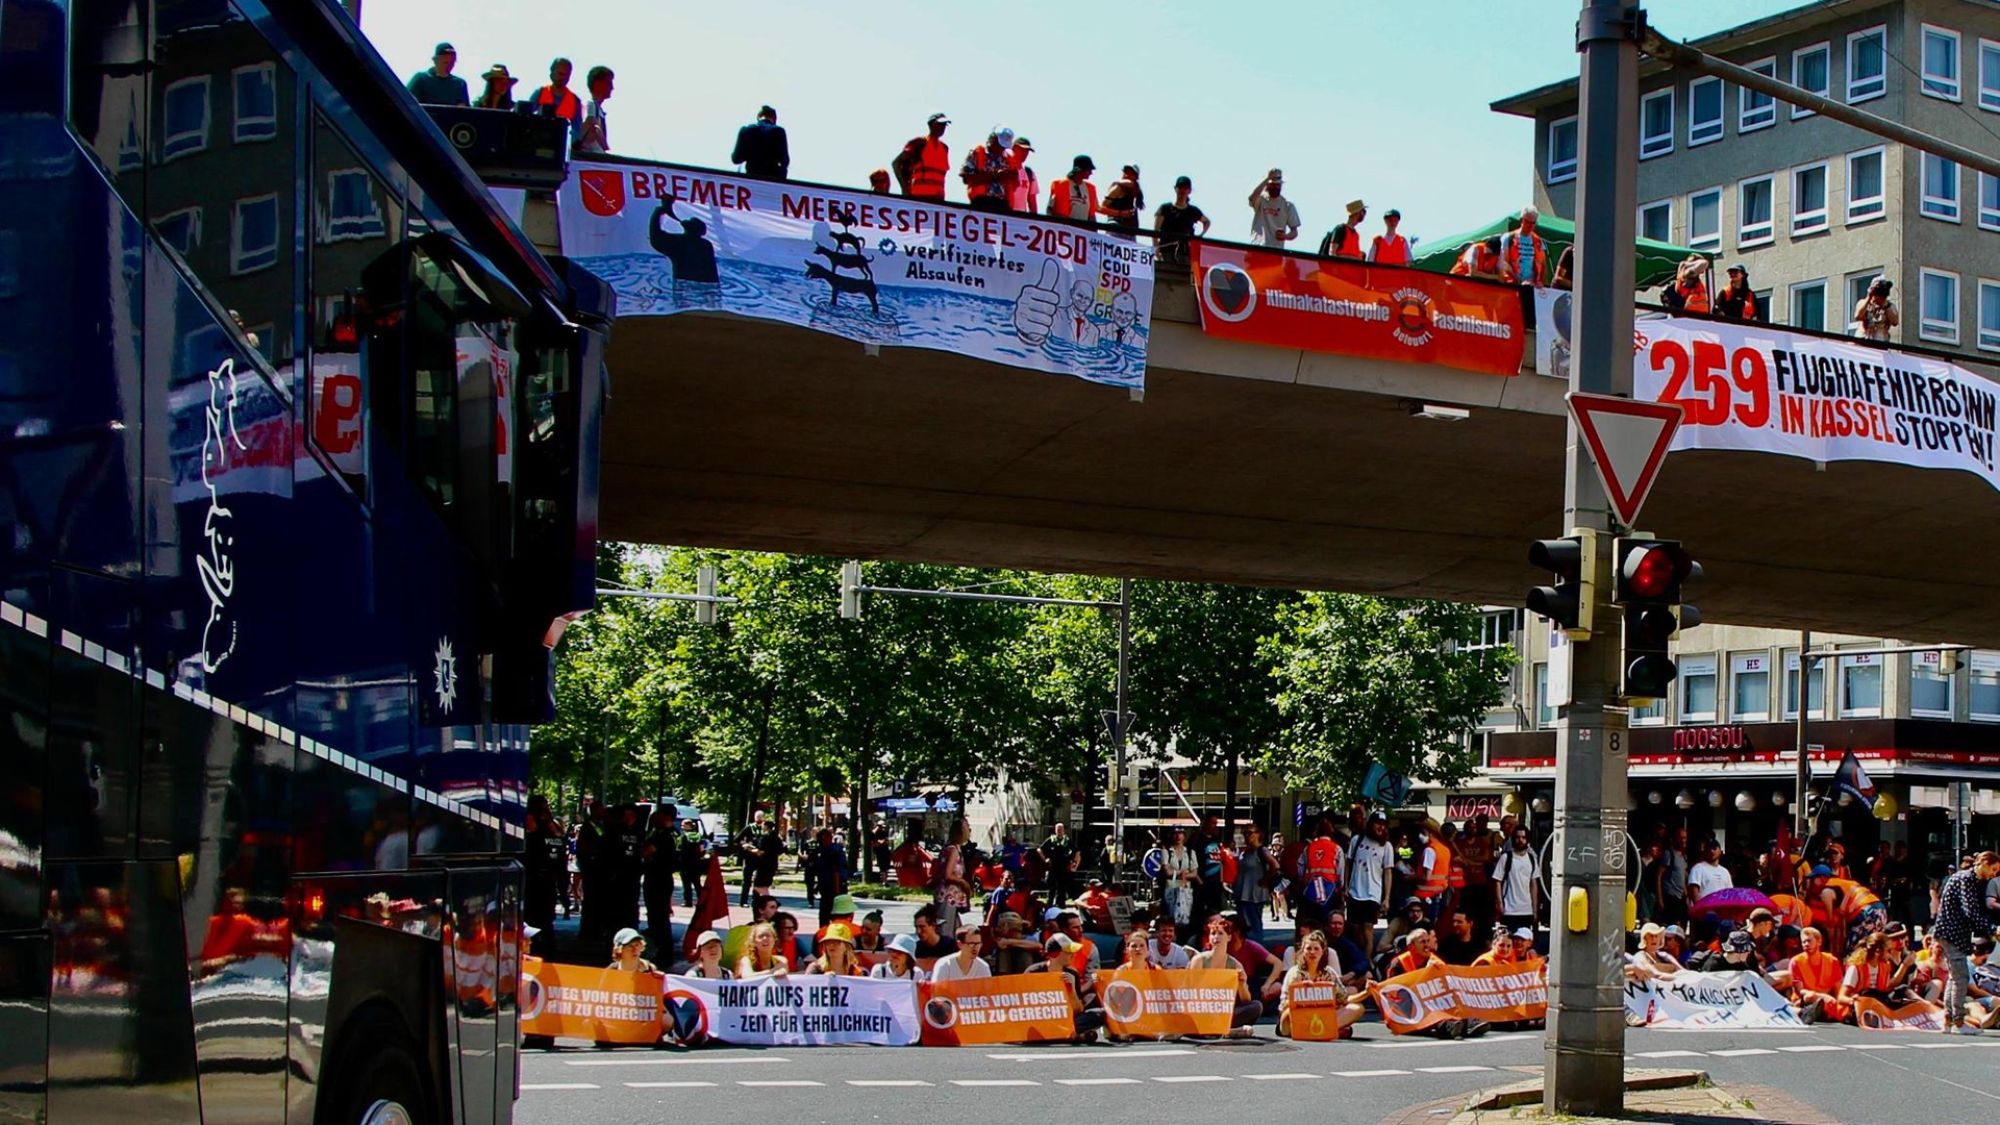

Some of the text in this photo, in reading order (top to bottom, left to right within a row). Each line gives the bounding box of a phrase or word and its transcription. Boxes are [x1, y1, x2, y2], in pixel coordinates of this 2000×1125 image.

[631, 171, 752, 212] BREMER
[903, 243, 1025, 273] verifiziertes
[1103, 242, 1155, 266] MADE BY
[906, 261, 985, 288] Absaufen
[1102, 259, 1130, 276] CDU
[1100, 272, 1131, 293] SPD
[1265, 288, 1390, 322] Klimakatastrophe
[1432, 309, 1511, 340] Faschismus
[1772, 349, 1996, 432] FLUGHAFENIRRSINN
[1779, 393, 1994, 472] IN KASSEL STOPPEN!
[1609, 732, 1620, 751] 8
[1448, 797, 1499, 818] KIOSK
[547, 986, 658, 1008] WEG VON FOSSIL
[718, 985, 849, 1008] HAND AUFS HERZ
[1144, 988, 1235, 1002] WEG VON FOSSIL
[1294, 986, 1333, 1002] ALARM
[1415, 977, 1446, 1000] DIE
[547, 1000, 658, 1022] HIN ZU GERECHT
[956, 990, 1068, 1010] WEG VON FOSSIL
[1145, 1002, 1168, 1014] HIN
[740, 1015, 768, 1033] ZEIT
[773, 1011, 798, 1032] FÜR
[802, 1014, 892, 1034] EHRLICHKEIT
[960, 1005, 1069, 1025] HIN ZU GERECHT
